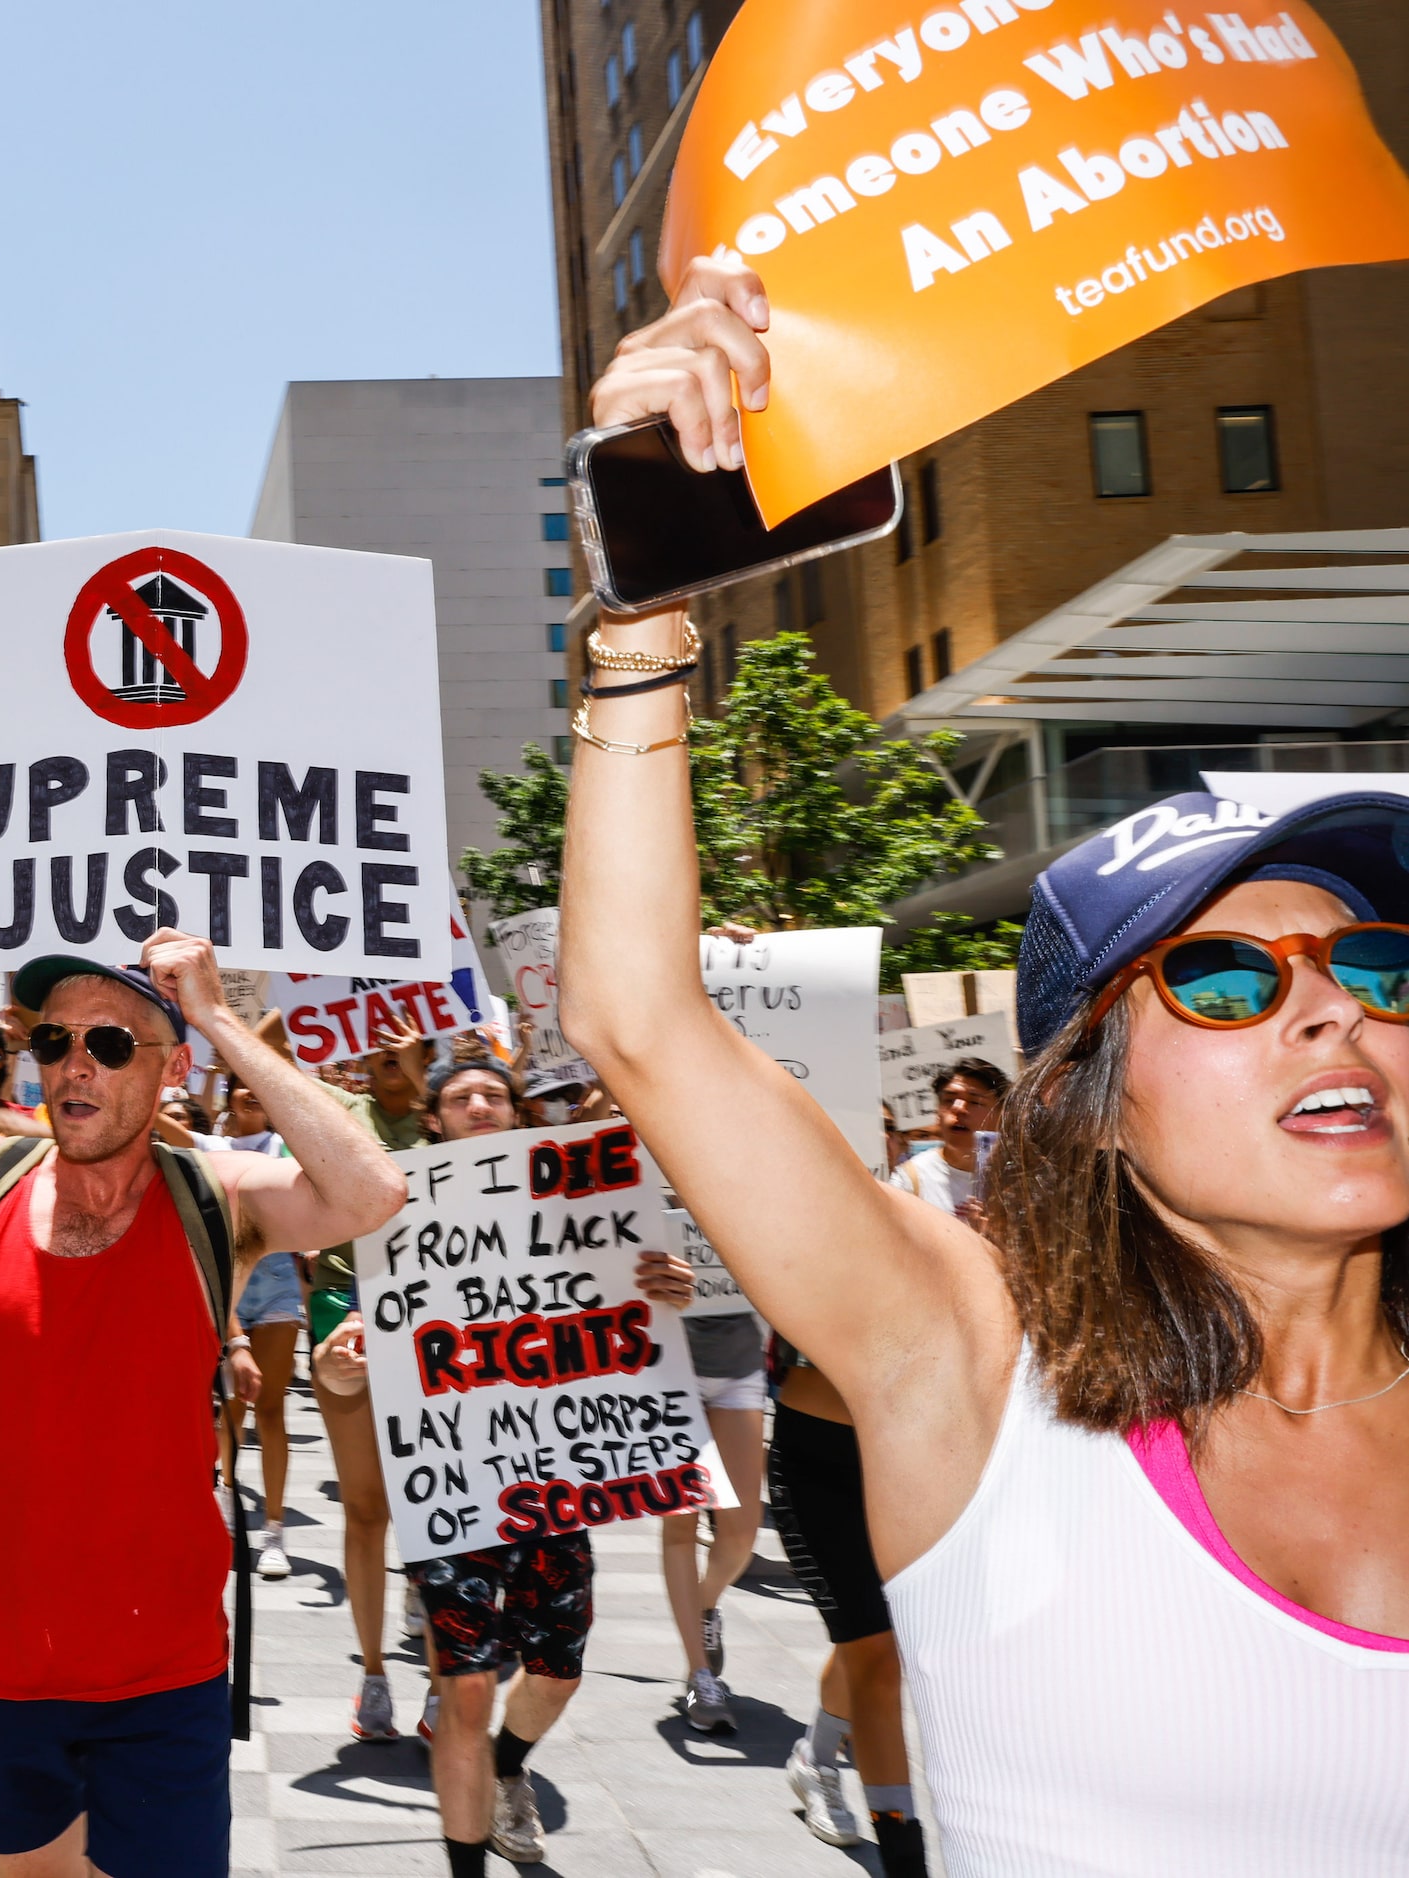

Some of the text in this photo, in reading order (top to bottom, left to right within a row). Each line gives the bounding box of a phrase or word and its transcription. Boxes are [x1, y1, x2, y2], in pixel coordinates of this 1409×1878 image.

[723, 0, 1056, 181] Everyon
[1021, 9, 1225, 101] Who's
[1204, 11, 1320, 64] Had
[900, 98, 1290, 292] An Abortion
[1054, 203, 1286, 316] teafund.org
[473, 1153, 521, 1194] I
[529, 1124, 641, 1200] DIE
[383, 1219, 508, 1277] FROM
[528, 1209, 643, 1257] LACK
[374, 1270, 604, 1333] OF BASIC
[386, 1389, 694, 1458] LAY MY CORPSE
[402, 1431, 701, 1505] ON THE STEPS
[426, 1504, 481, 1546] OF
[496, 1462, 720, 1544] SCOTUS
